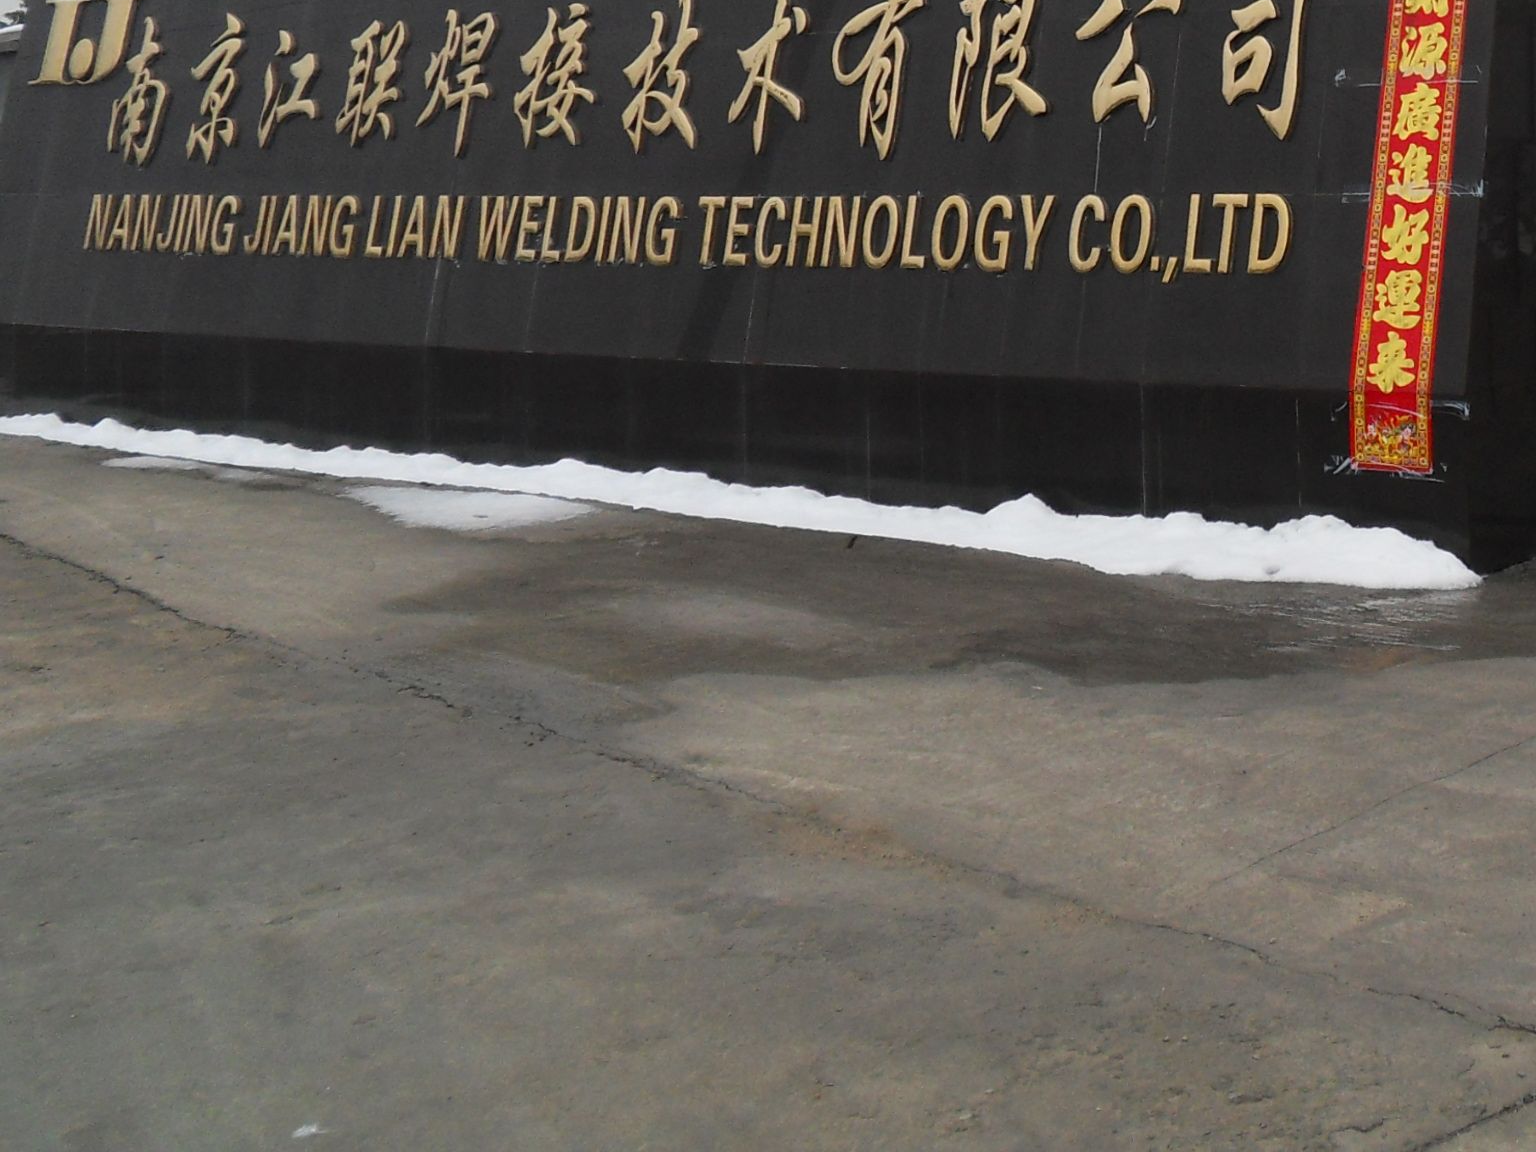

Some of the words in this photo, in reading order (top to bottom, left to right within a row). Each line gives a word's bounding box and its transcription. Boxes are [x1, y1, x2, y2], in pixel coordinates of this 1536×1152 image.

[83, 192, 241, 256] NANJING
[242, 194, 360, 259] JIANG
[364, 194, 466, 260] LIAN
[476, 194, 684, 265] WELDING
[698, 193, 1056, 273] TECHNOLOGY
